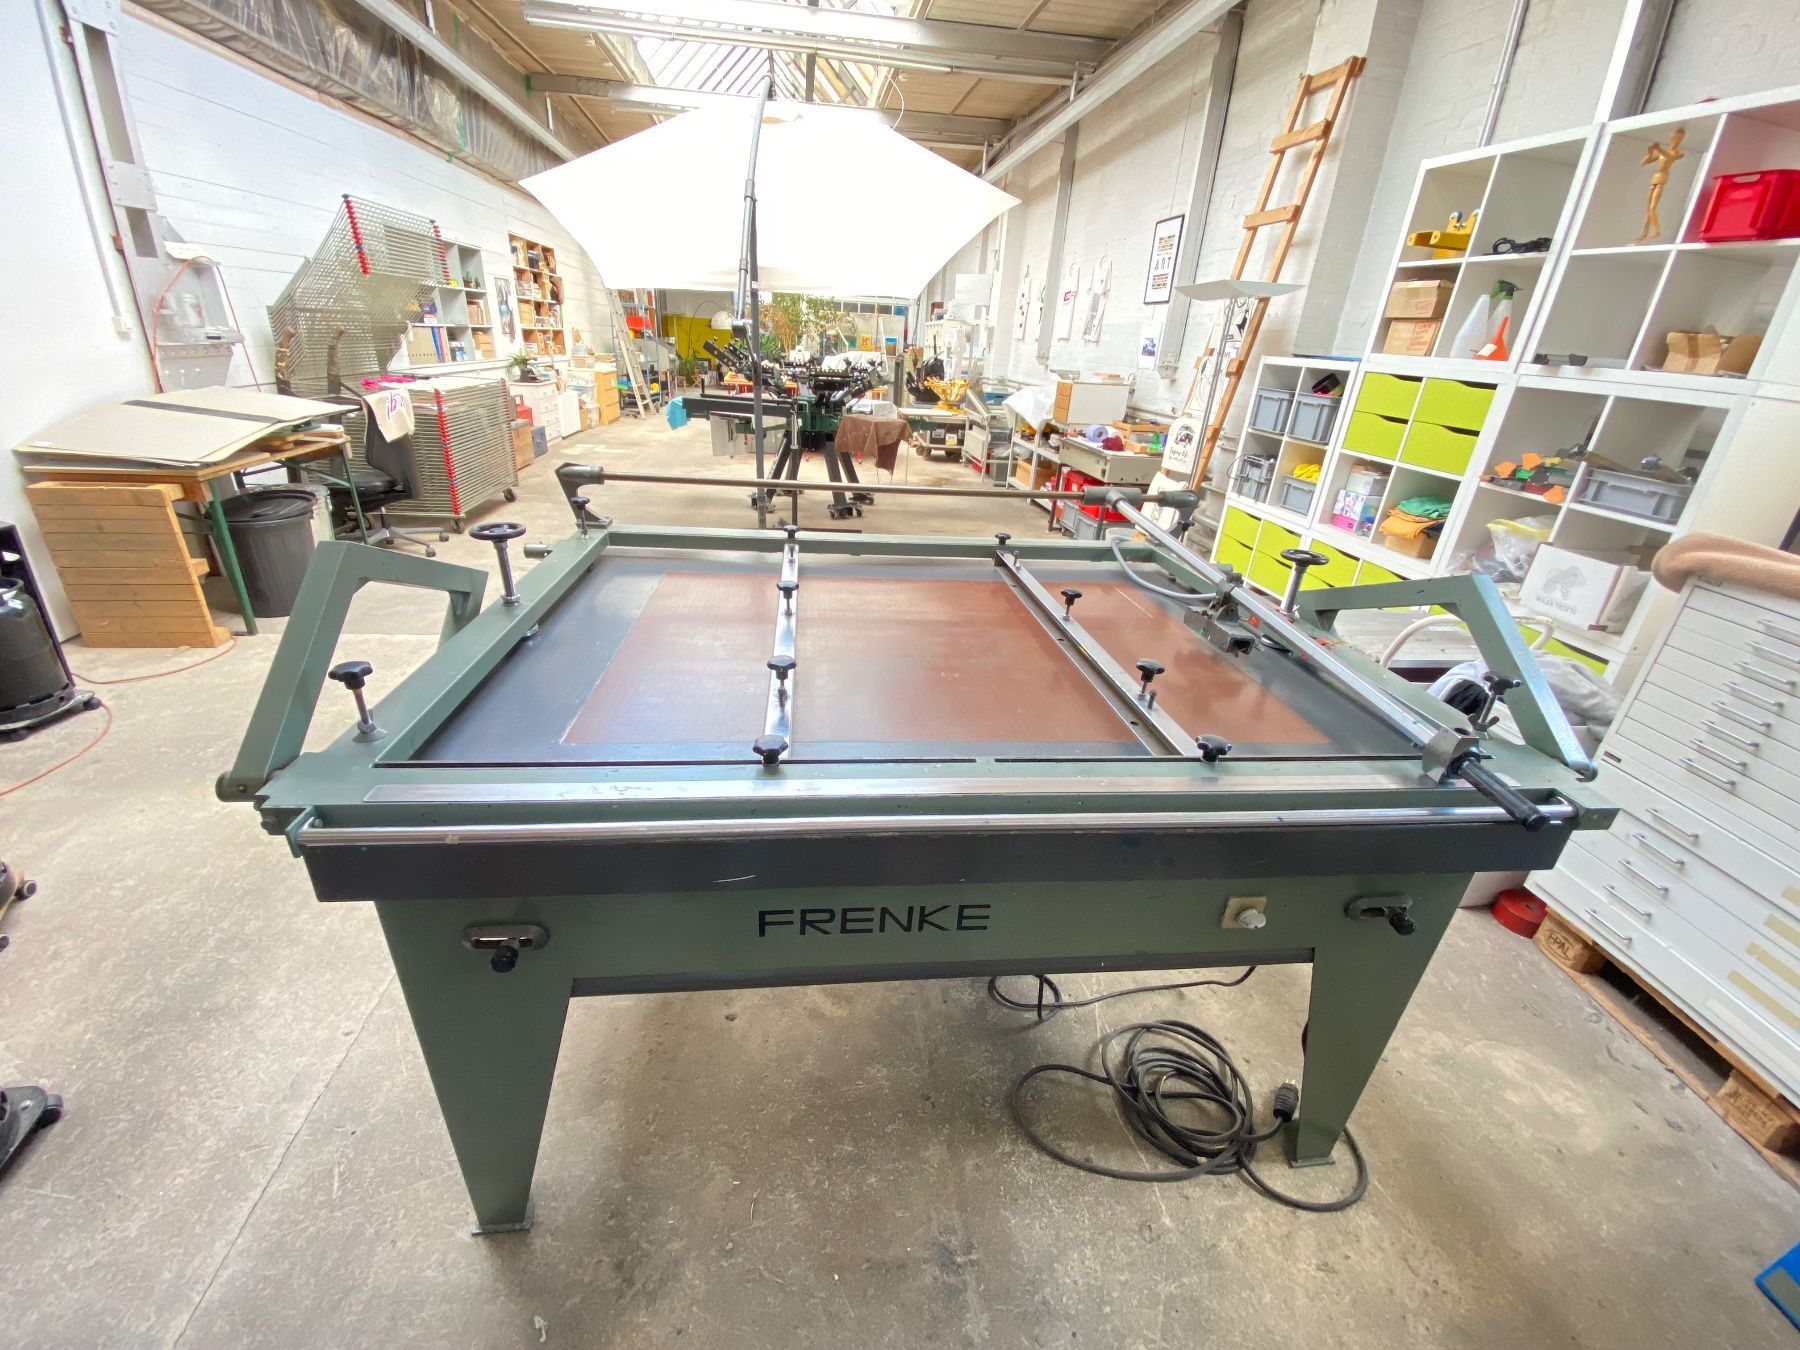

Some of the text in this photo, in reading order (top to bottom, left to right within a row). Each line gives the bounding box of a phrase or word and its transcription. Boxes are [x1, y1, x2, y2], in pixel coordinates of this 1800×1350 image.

[1154, 256, 1172, 271] ART
[758, 904, 991, 937] FRENKE
[1546, 931, 1570, 958] EPAL
